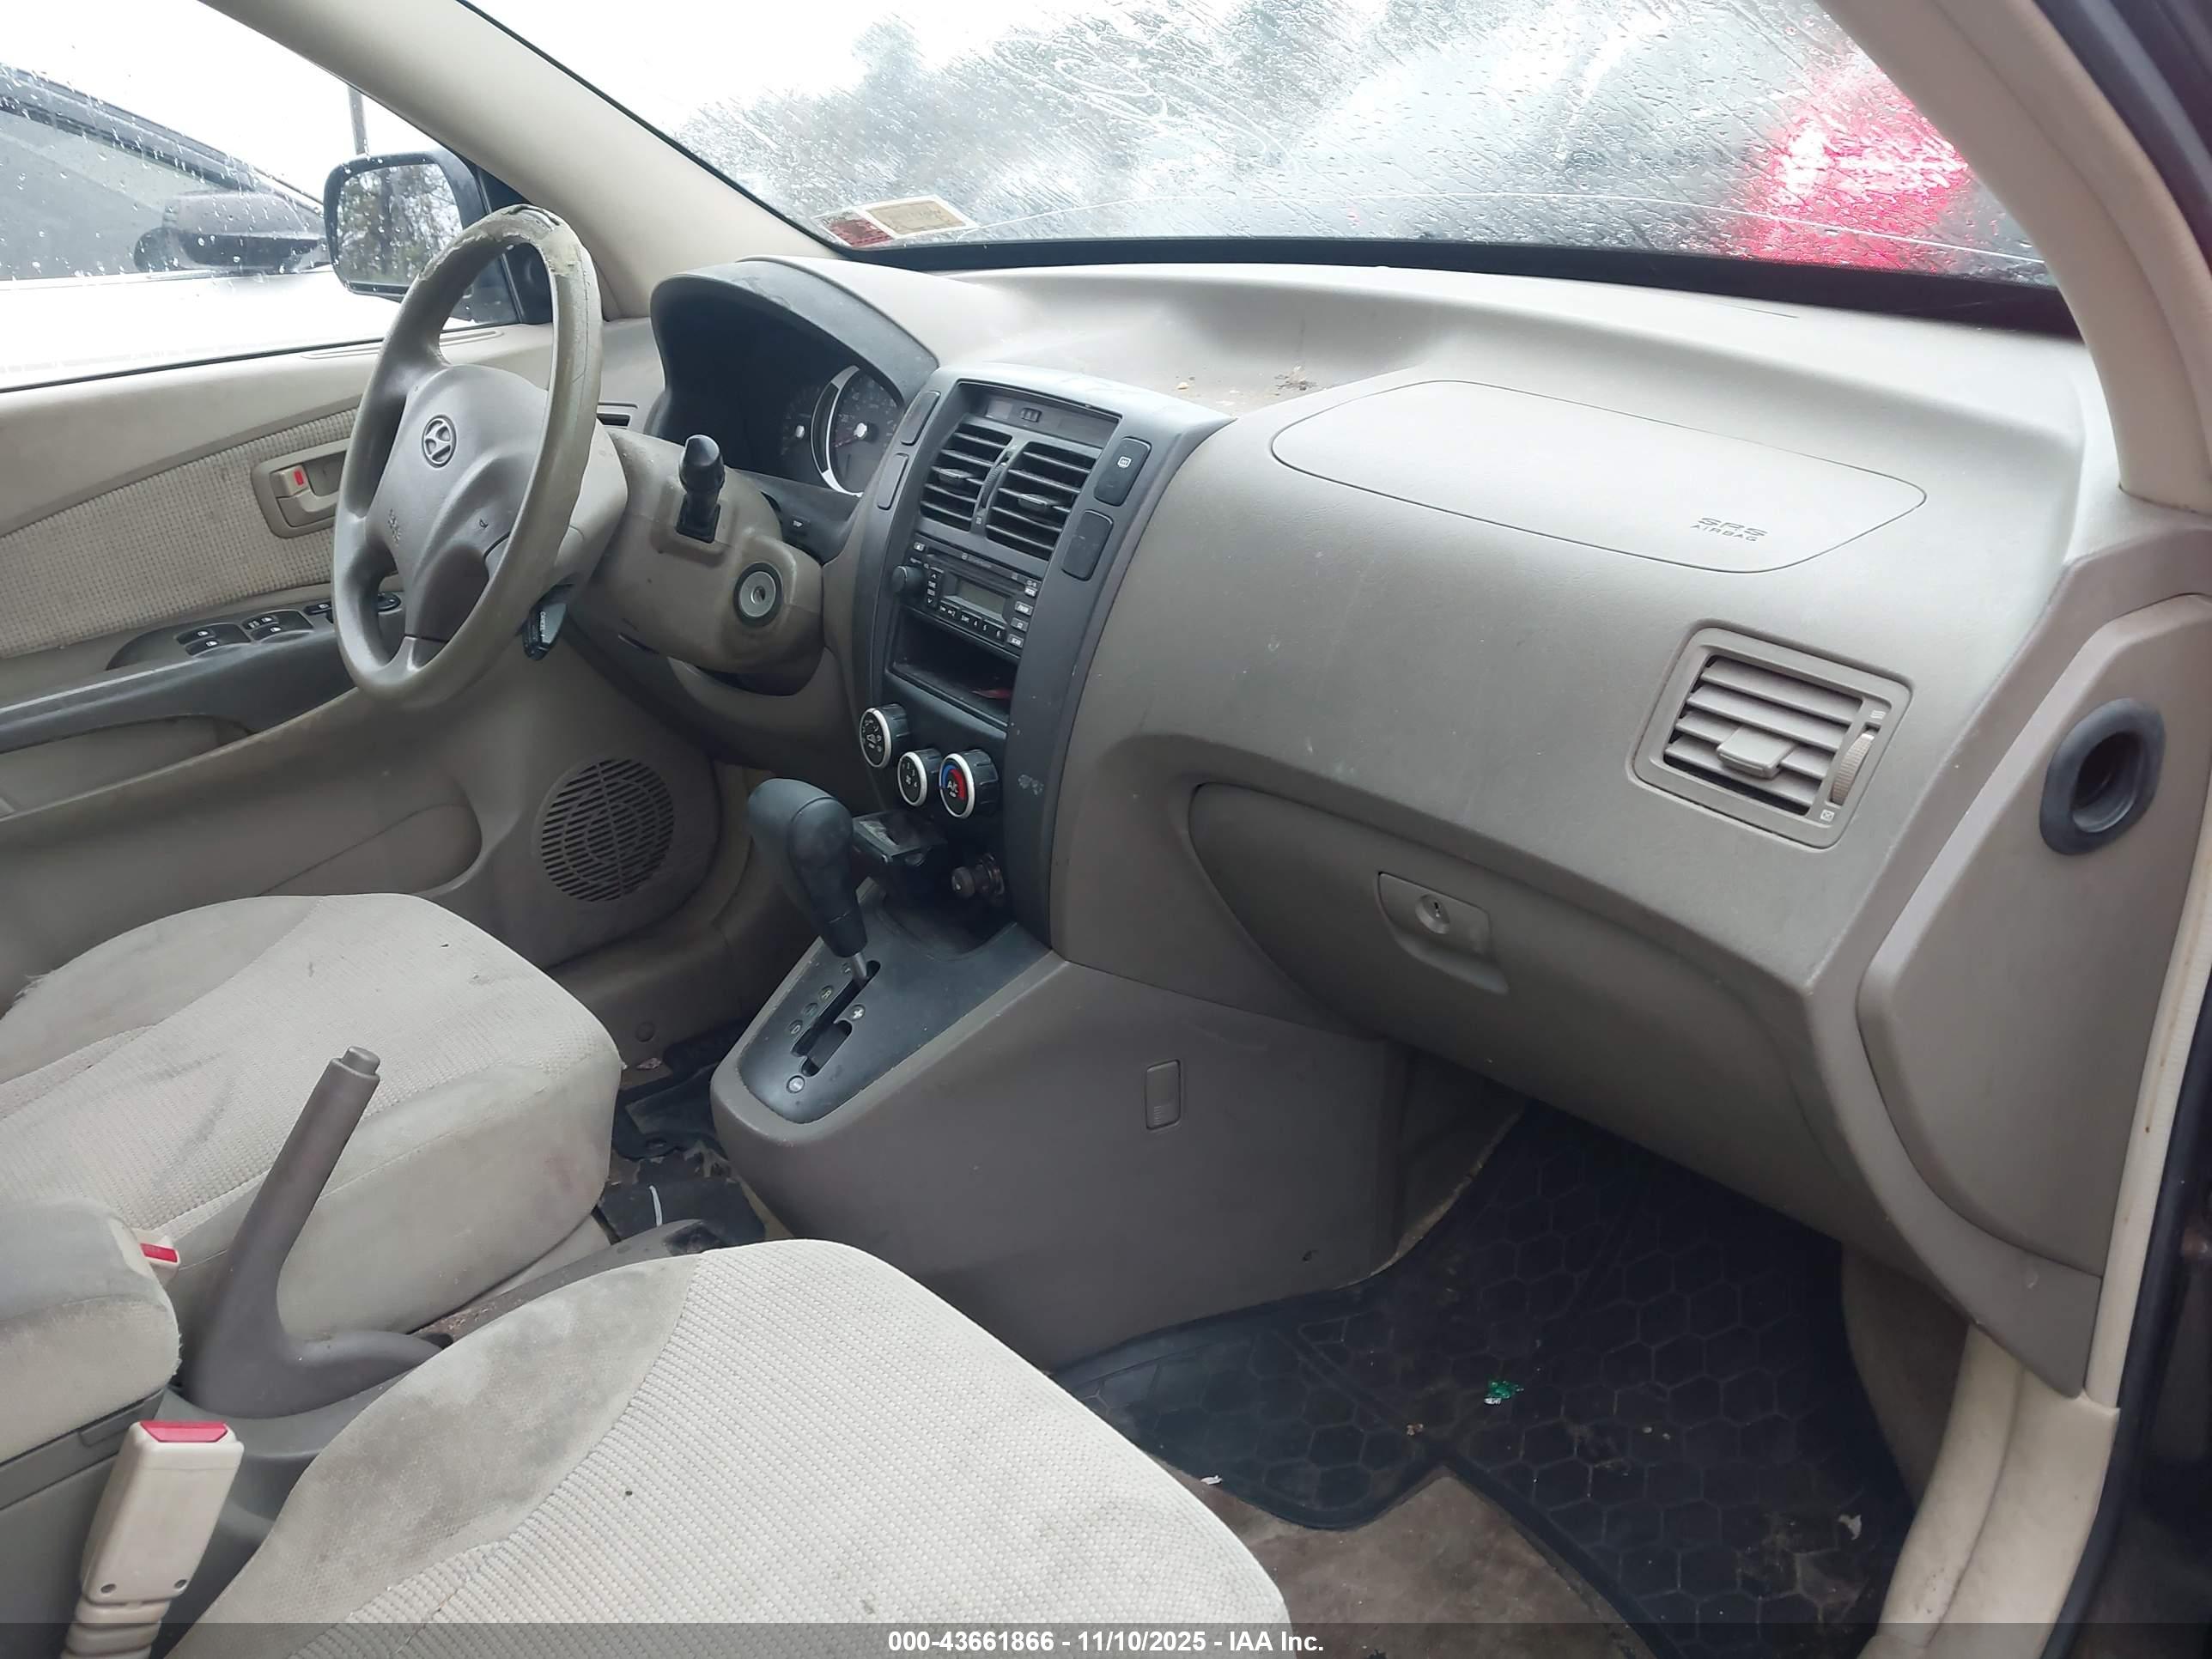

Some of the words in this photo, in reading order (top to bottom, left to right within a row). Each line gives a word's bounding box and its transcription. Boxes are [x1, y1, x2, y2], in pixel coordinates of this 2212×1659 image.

[1690, 524, 1757, 542] AIRBAG
[1698, 517, 1768, 537] SRS
[822, 989, 832, 1000] R
